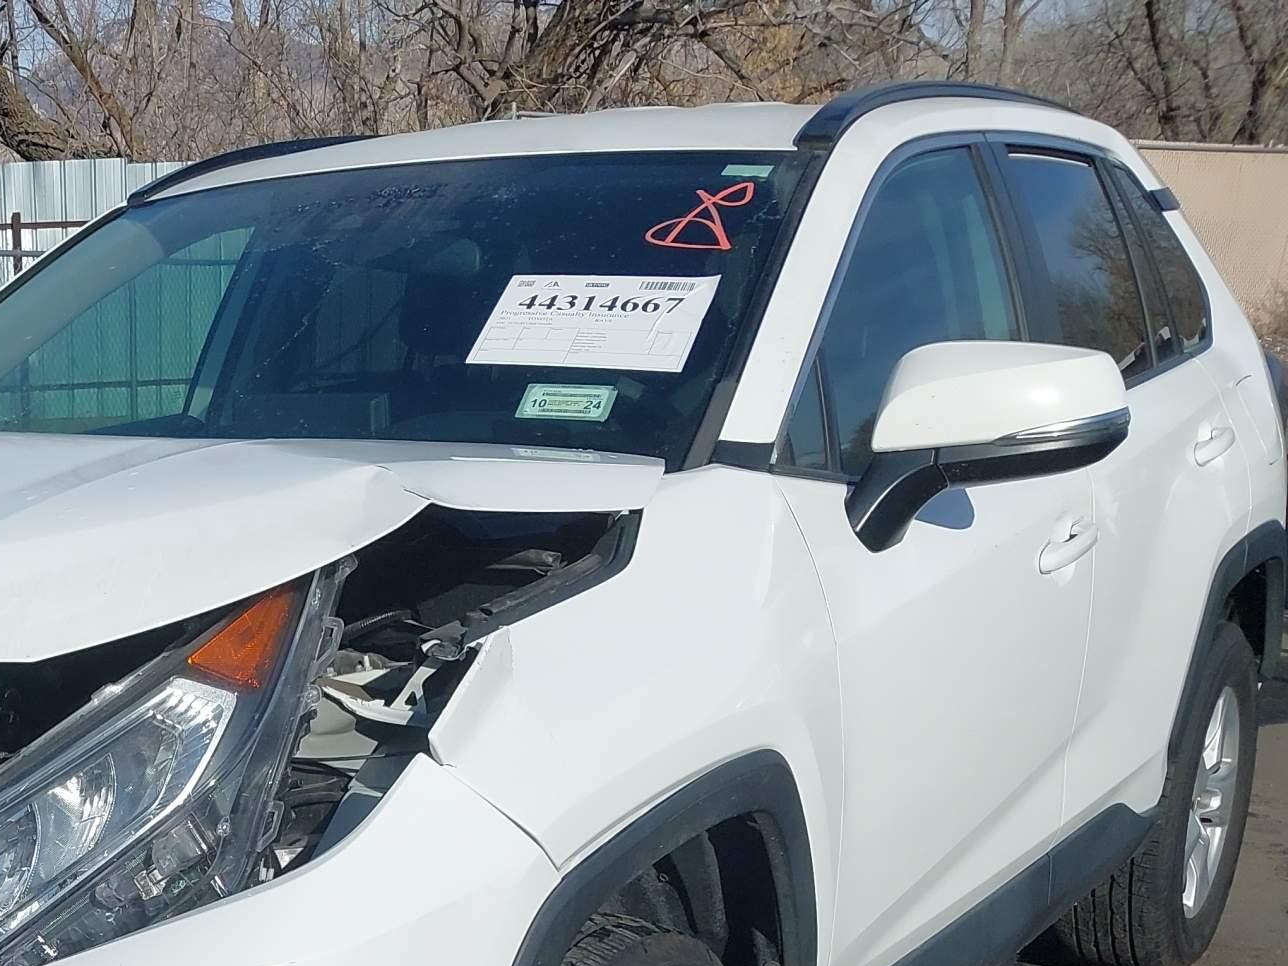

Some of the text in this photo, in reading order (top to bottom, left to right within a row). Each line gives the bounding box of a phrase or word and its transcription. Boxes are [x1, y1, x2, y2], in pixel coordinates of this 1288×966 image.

[517, 294, 686, 314] 44314667
[531, 398, 548, 408] 10
[583, 400, 602, 410] 24
